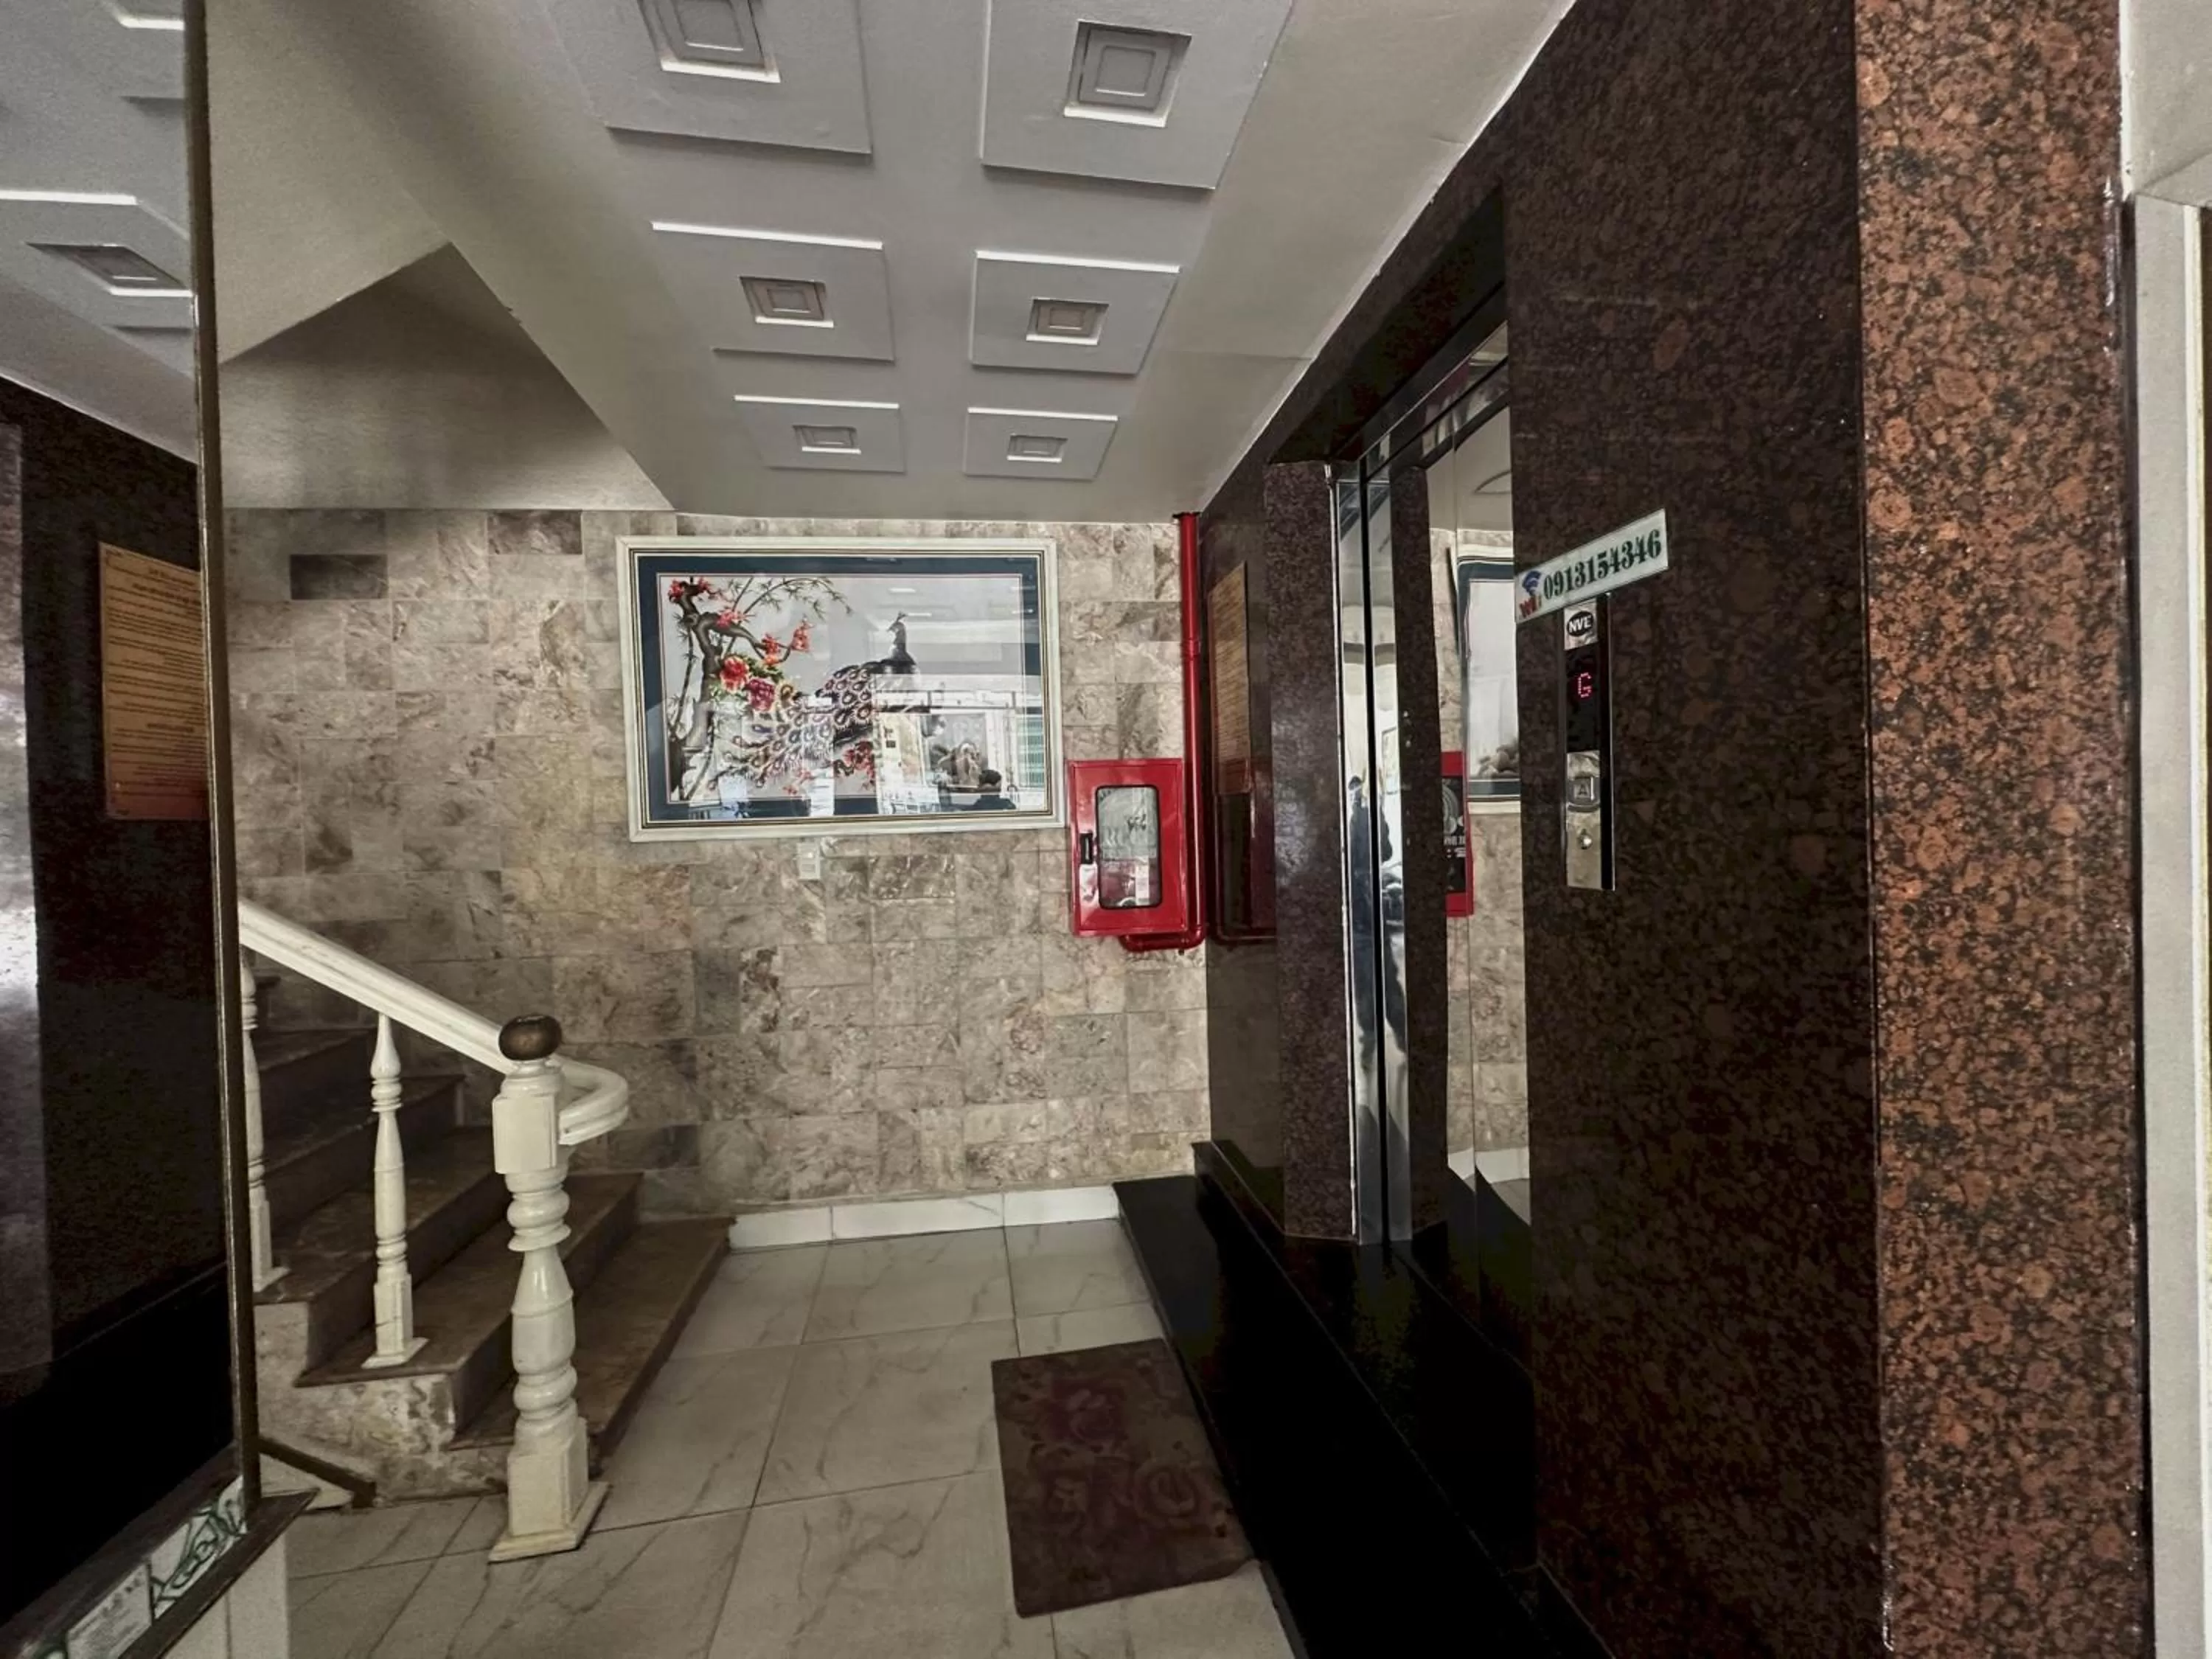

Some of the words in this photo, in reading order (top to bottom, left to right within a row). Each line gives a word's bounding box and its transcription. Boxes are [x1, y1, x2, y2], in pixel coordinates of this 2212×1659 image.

[1543, 529, 1661, 599] 0913154346
[1568, 615, 1592, 633] NVE
[1578, 672, 1592, 698] G
